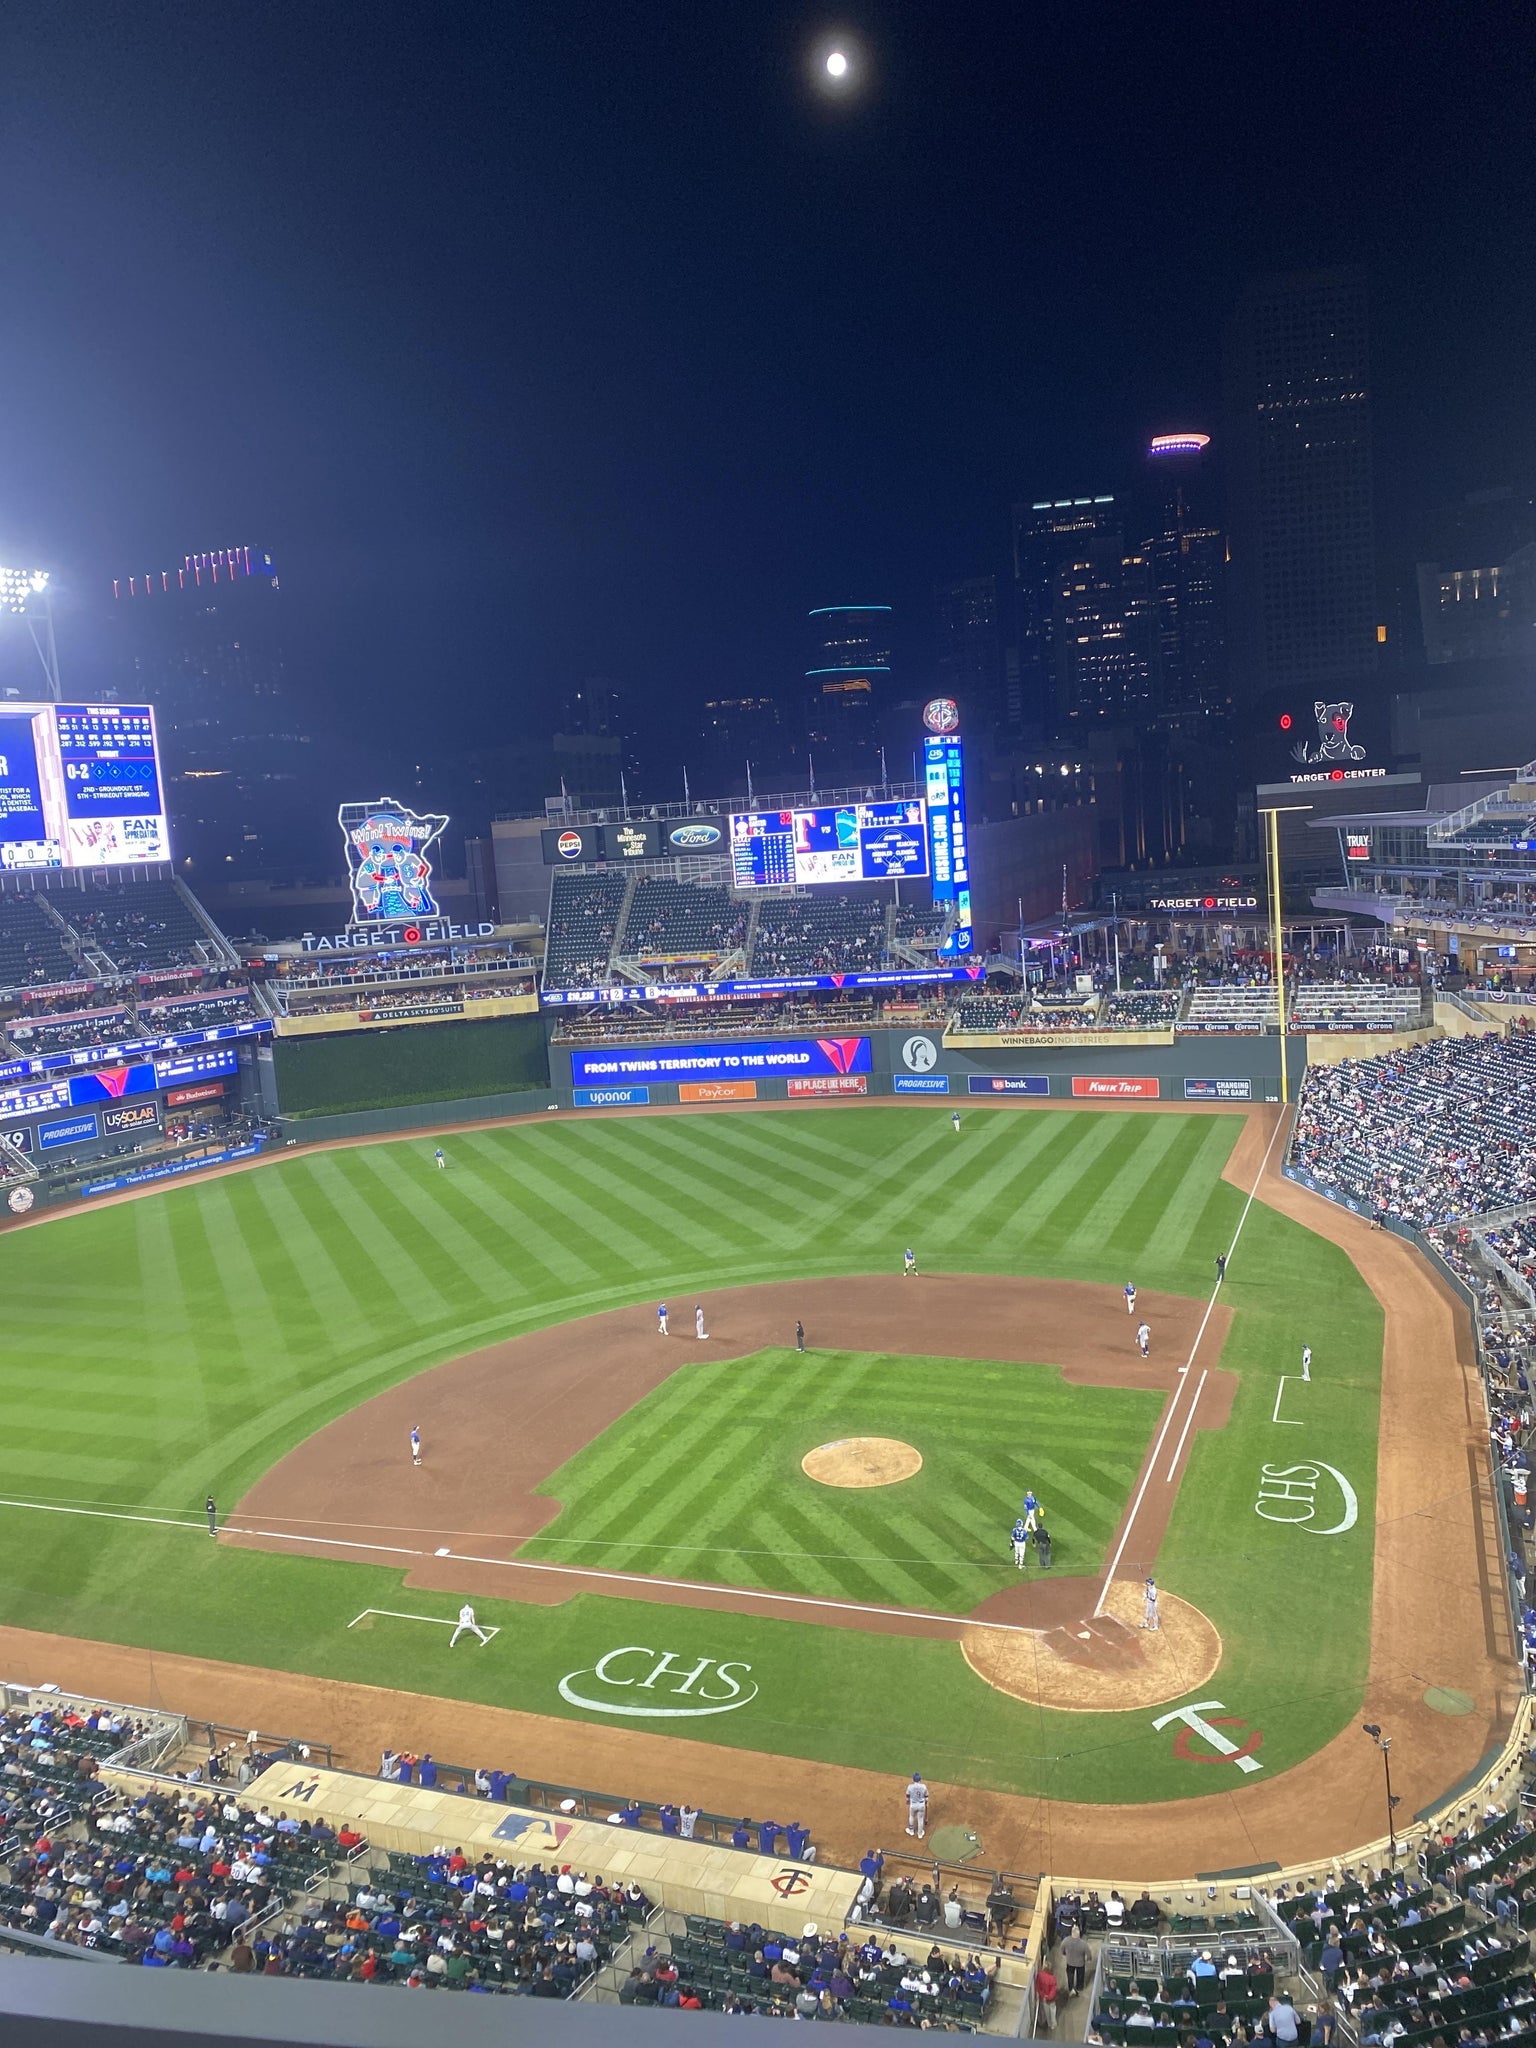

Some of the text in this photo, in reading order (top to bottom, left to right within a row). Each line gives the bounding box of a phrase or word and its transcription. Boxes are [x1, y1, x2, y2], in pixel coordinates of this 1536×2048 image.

[66, 764, 90, 780] 0-2
[1290, 768, 1386, 783] TARGET CENTER
[122, 819, 157, 830] FAN
[350, 819, 432, 845] Win! Twins!
[622, 827, 634, 835] The
[616, 834, 646, 842] Minnesota
[680, 831, 710, 843] Ford
[1346, 836, 1368, 846] TRULY
[630, 842, 644, 850] Star
[622, 848, 644, 856] Tribune
[1150, 898, 1256, 908] TARGET FIELD
[302, 922, 494, 950] TARGET FIELD
[30, 984, 87, 999] Treasure Island
[734, 992, 760, 1000] AUCTIONS
[1176, 1023, 1259, 1031] Corona Corona Corona
[1290, 1022, 1392, 1030] Corona Corona Corona
[1001, 1036, 1109, 1044] WINNEBAGO INDUSTRIES
[584, 1053, 810, 1074] FROM TWINS TERRITORY TO THE WORLD
[802, 1080, 827, 1090] PLACE
[840, 1078, 859, 1088] HERE
[898, 1080, 946, 1088] PROGRESSIVE
[186, 1089, 216, 1100] Budweiser
[590, 1091, 632, 1104] uponor
[699, 1086, 736, 1098] Paycor
[43, 1123, 94, 1140] PROGRESSIVE
[125, 1174, 145, 1184] There's
[172, 1165, 182, 1173] Just
[184, 1162, 198, 1171] great
[1255, 1464, 1320, 1522] CHS
[596, 1646, 751, 1699] CHS
[867, 1953, 872, 1962] 5
